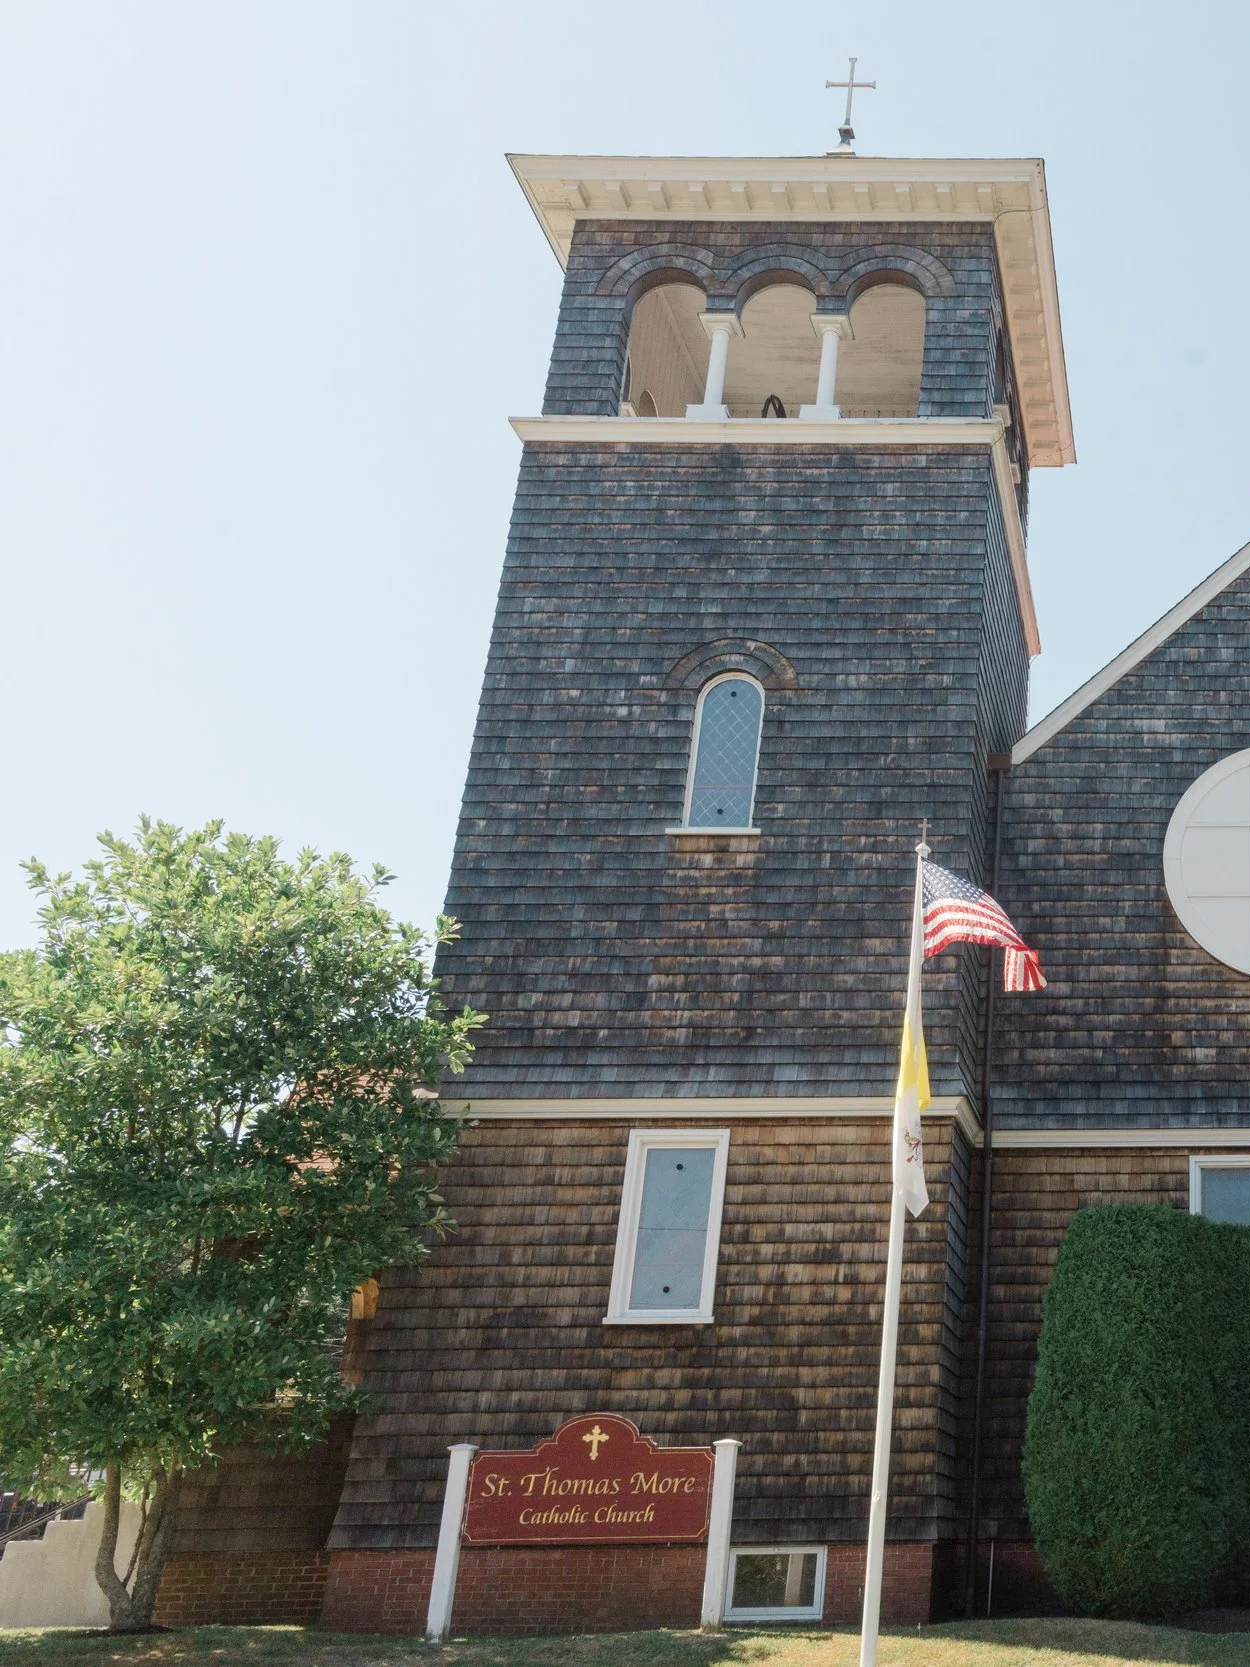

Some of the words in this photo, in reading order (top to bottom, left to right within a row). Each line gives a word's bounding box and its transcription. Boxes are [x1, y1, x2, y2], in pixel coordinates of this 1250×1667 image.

[480, 1473, 513, 1498] St.
[520, 1466, 622, 1497] Thomas
[630, 1471, 696, 1495] More
[519, 1504, 589, 1526] Catholic
[594, 1502, 655, 1525] Church
